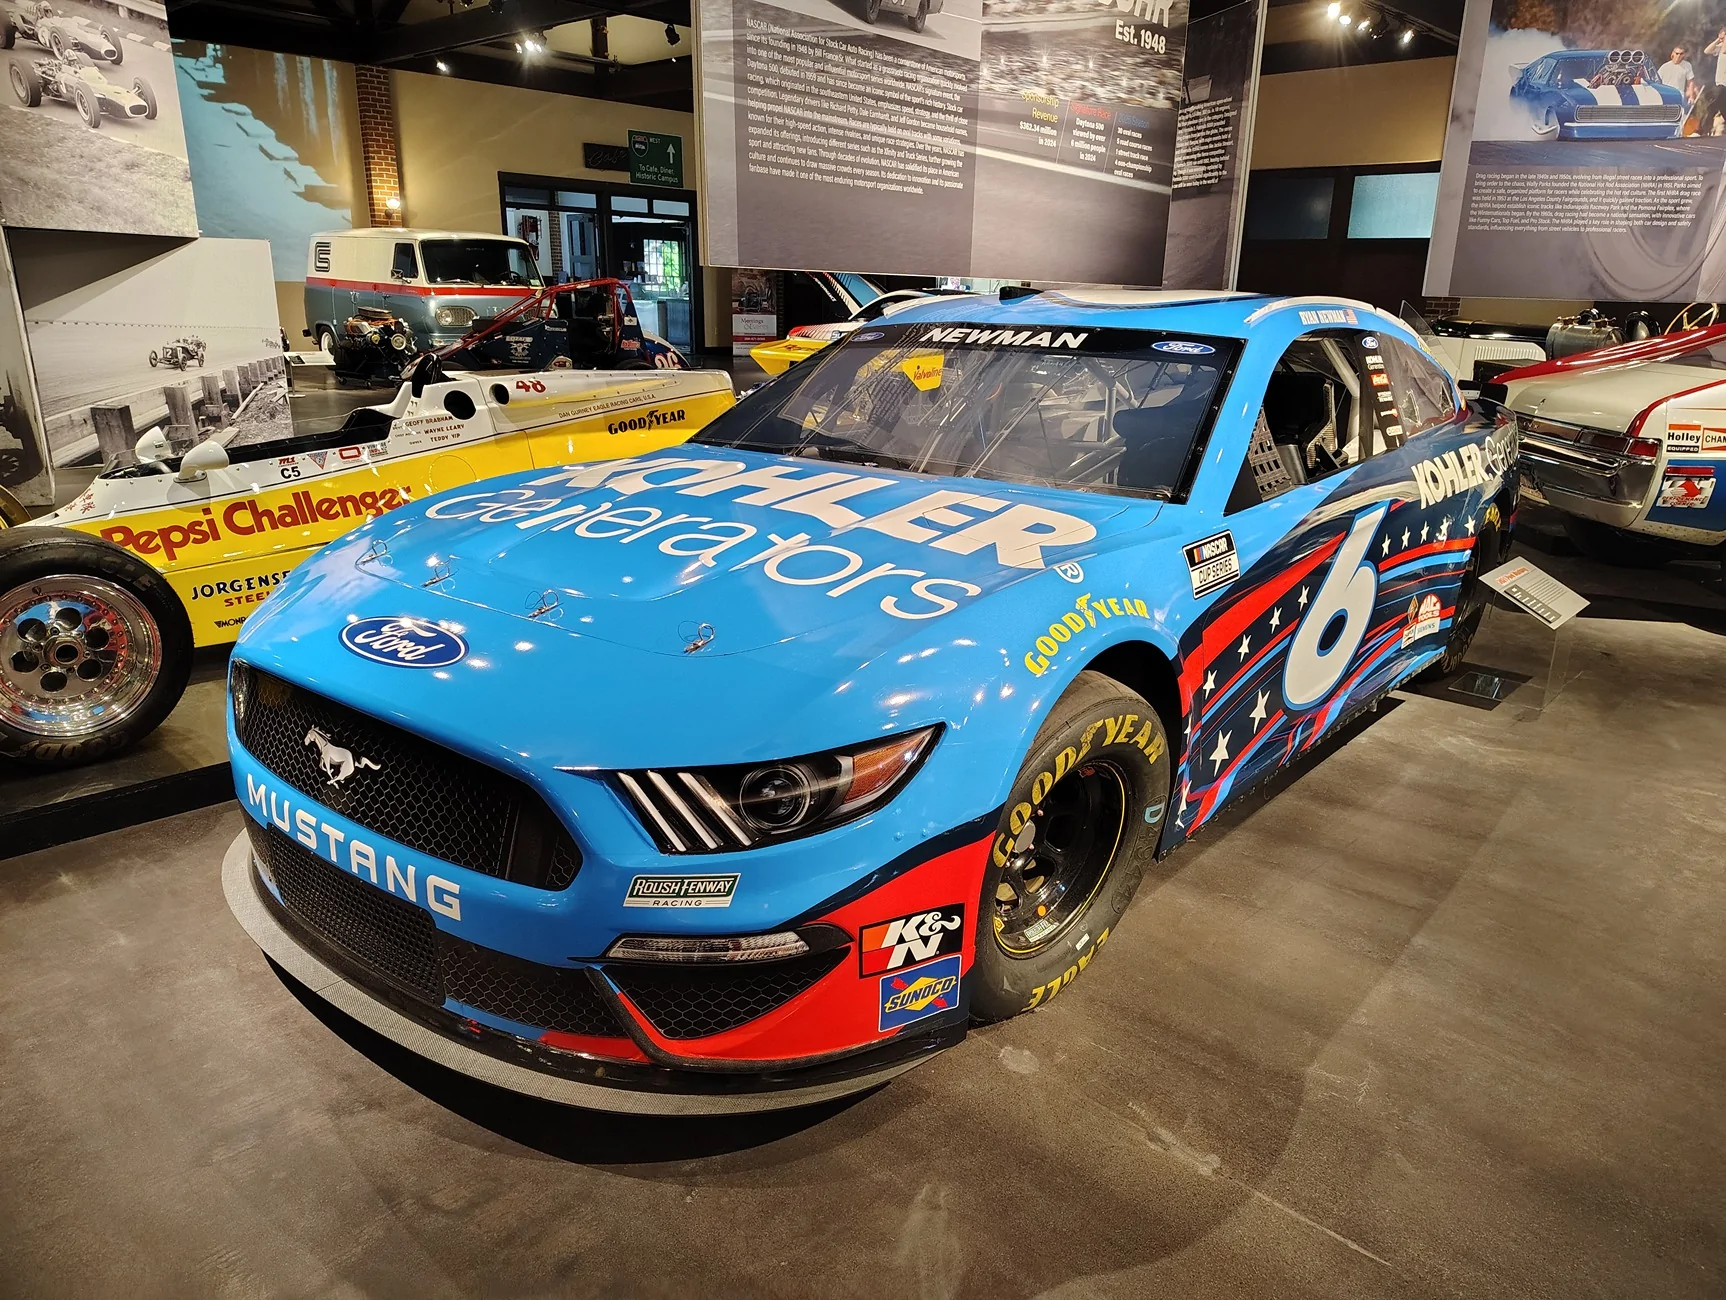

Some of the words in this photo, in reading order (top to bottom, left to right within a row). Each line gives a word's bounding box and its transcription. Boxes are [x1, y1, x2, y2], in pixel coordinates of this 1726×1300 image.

[1115, 19, 1137, 45] Est.
[1140, 29, 1166, 54] 1948
[746, 17, 767, 31] NASCAR
[768, 23, 790, 36] (National
[791, 28, 817, 43] Association
[825, 37, 837, 48] Stock
[847, 42, 857, 53] Auto
[858, 45, 873, 58] Racing)
[874, 49, 882, 59] has
[883, 51, 893, 62] been
[921, 61, 925, 70] of
[926, 62, 943, 74] American
[1022, 89, 1059, 108] Sponsorship
[1032, 107, 1058, 123] Revenue
[1071, 104, 1097, 117] Signature
[1098, 107, 1111, 119] Race
[1040, 125, 1057, 136] million
[1076, 118, 1095, 129] Daytona
[1096, 122, 1104, 130] 500
[1044, 138, 1056, 148] 2024
[1073, 129, 1089, 139] viewed
[1090, 132, 1095, 141] by
[1095, 134, 1106, 142] over
[1120, 139, 1128, 147] road
[1074, 140, 1090, 150] million
[1091, 144, 1106, 154] people
[1118, 150, 1129, 158] street
[1084, 152, 1096, 161] 2024
[635, 172, 656, 180] Historic
[657, 174, 678, 183] Campus
[748, 163, 768, 173] fanbase
[769, 166, 780, 175] have
[782, 169, 794, 177] made
[822, 174, 833, 182] most
[834, 175, 852, 187] enduring
[877, 182, 902, 191] organizations
[920, 328, 1088, 348] NEWMAN
[1161, 341, 1204, 354] Ford
[515, 379, 546, 393] 48
[558, 411, 572, 419] DAN
[571, 406, 592, 417] GURNEY
[593, 403, 609, 413] EAGLE
[610, 399, 628, 409] RACING
[405, 419, 424, 428] GEOFF
[425, 415, 454, 425] BRABHAM
[430, 434, 449, 443] TEDDY
[1668, 432, 1701, 443] Holley
[280, 465, 301, 479] C5
[1411, 443, 1489, 510] KOHLER
[520, 457, 1097, 569] KOHLER
[100, 507, 221, 561] Pepsi
[223, 485, 412, 535] Challenger
[425, 489, 982, 620] Generators
[1202, 537, 1229, 559] NASCAR
[1199, 567, 1211, 584] CUP
[1212, 558, 1232, 578] SERIES
[224, 591, 270, 607] STEE
[1282, 500, 1390, 709] 6
[354, 620, 445, 661] Ford
[247, 773, 462, 921] MUSTANG
[633, 879, 681, 896] ROUSH
[681, 879, 733, 896] FENWAY
[889, 976, 957, 1010] SUNOCO
